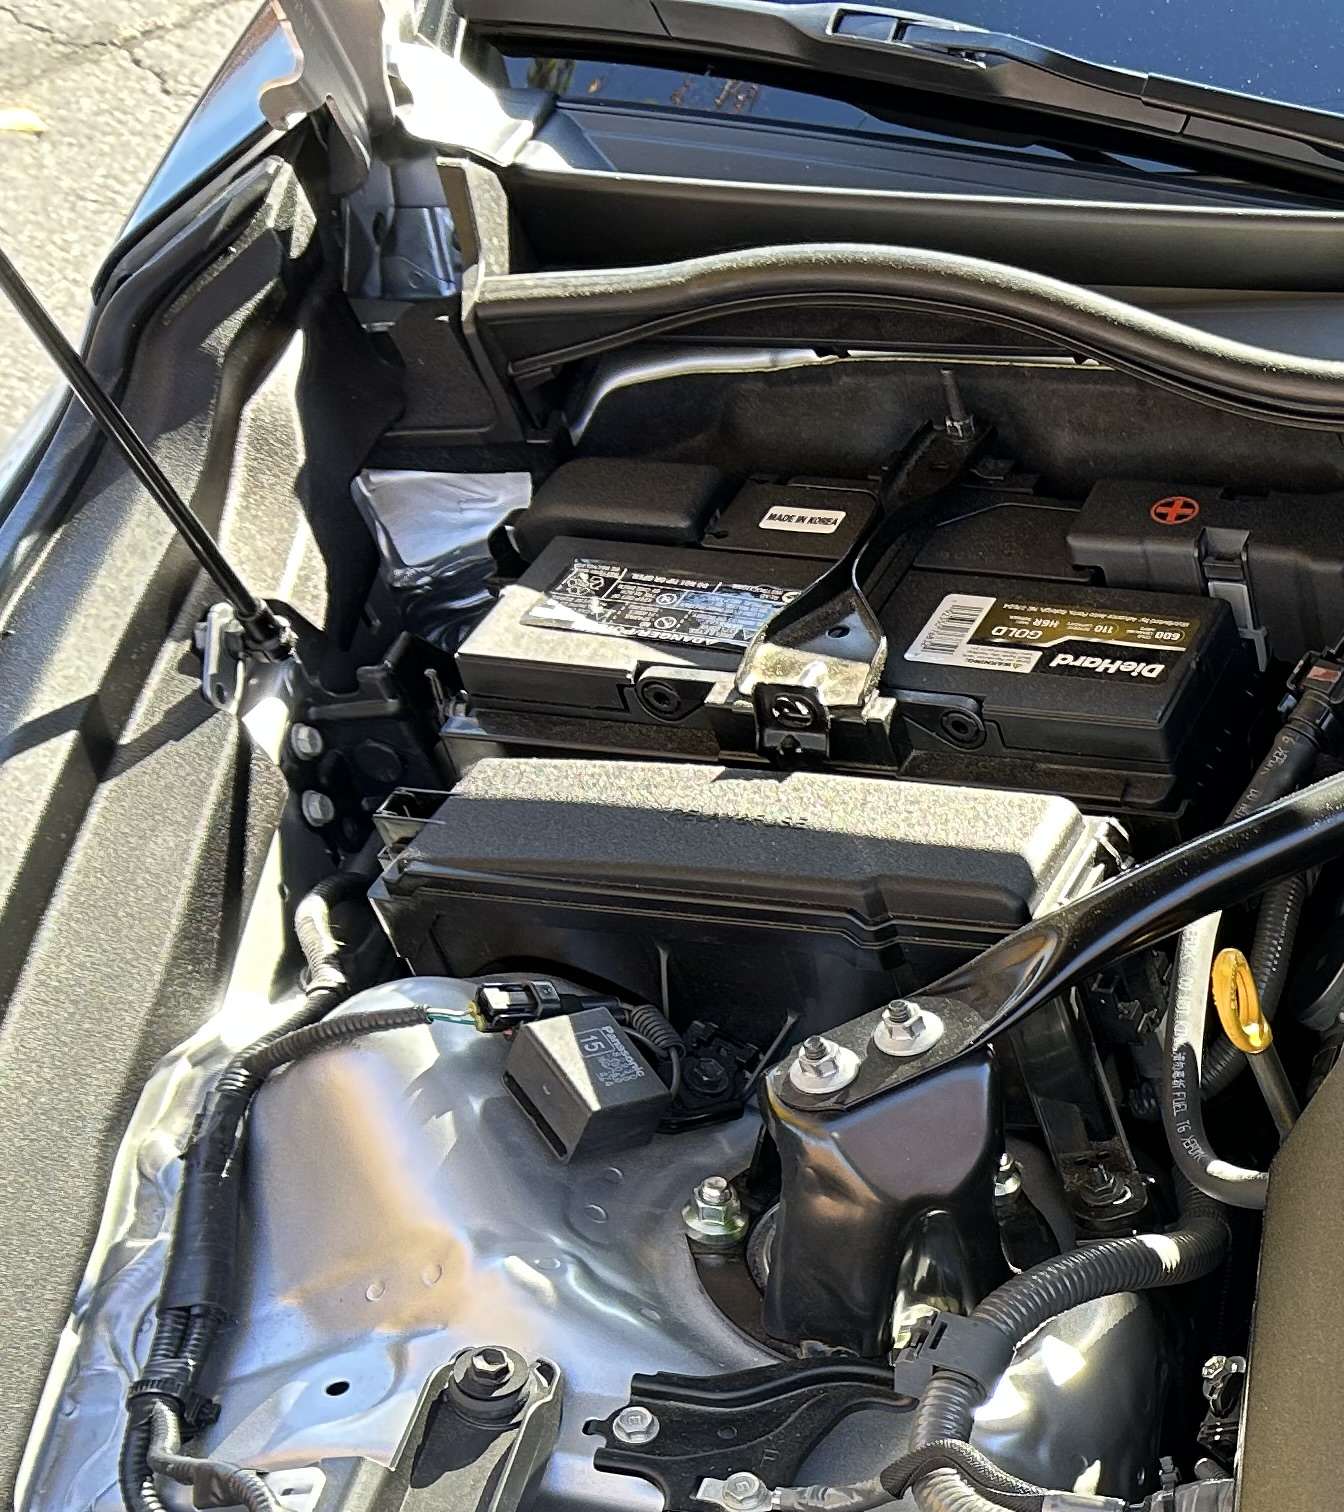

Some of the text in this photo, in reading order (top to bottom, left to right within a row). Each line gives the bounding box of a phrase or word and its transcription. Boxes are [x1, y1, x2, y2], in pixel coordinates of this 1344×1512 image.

[765, 513, 796, 524] MADE
[807, 516, 839, 526] KOREA
[991, 626, 1043, 639] GOLD
[1094, 624, 1114, 634] 110
[1154, 631, 1181, 640] 600
[1049, 653, 1166, 678] DieHard
[580, 1035, 606, 1052] 15
[601, 1025, 646, 1077] Panasonic
[1172, 1092, 1187, 1117] FUEL
